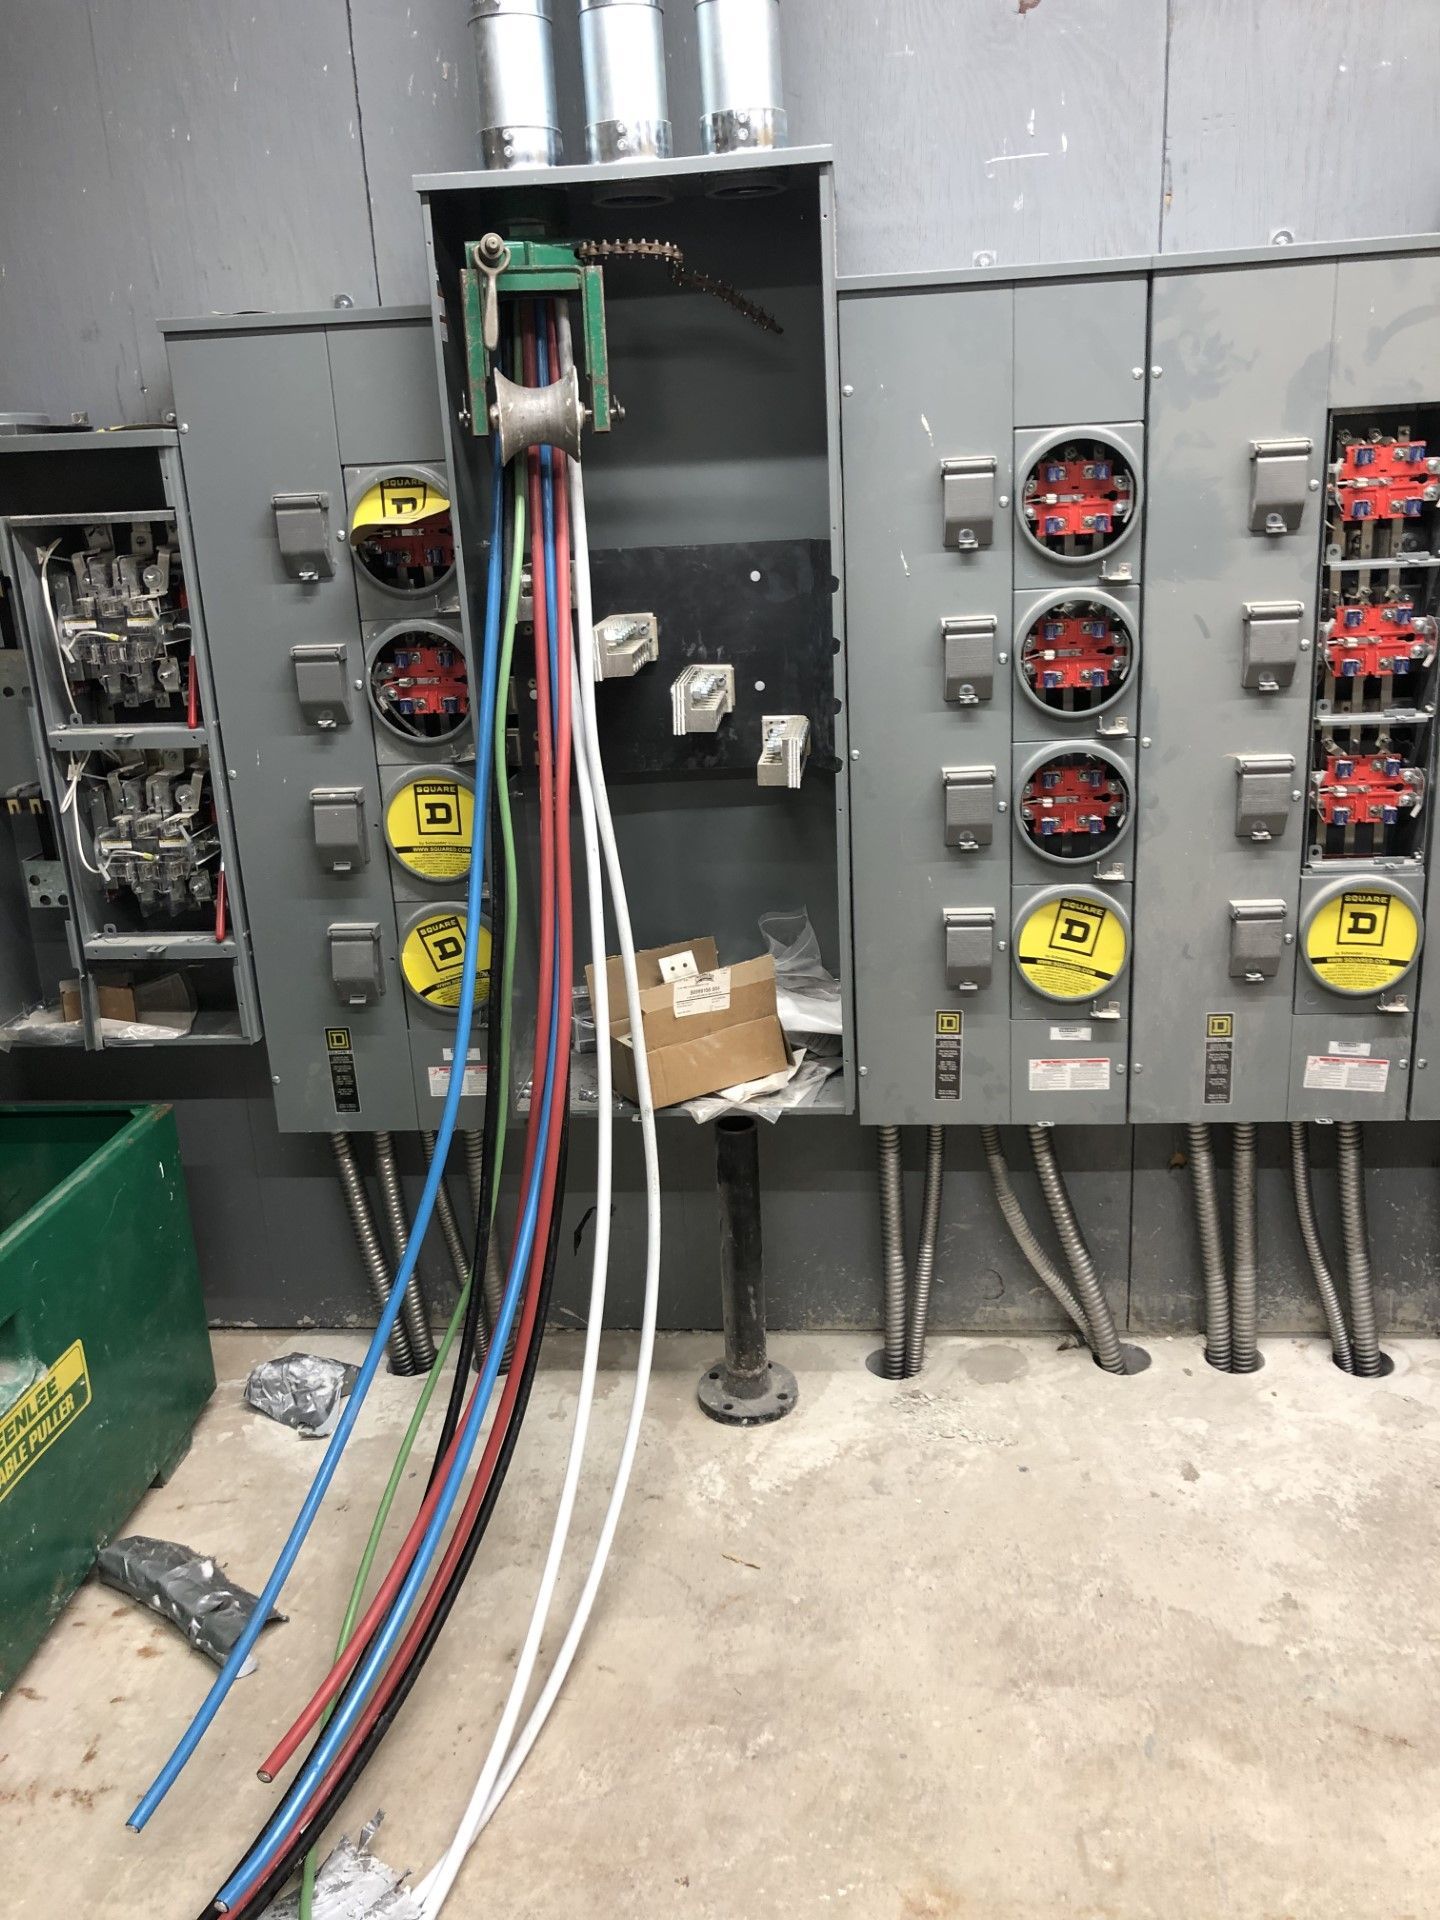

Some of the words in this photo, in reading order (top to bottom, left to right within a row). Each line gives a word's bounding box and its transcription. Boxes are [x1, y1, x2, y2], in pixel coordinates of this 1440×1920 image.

[383, 478, 424, 487] SQUARE
[424, 802, 453, 825] D
[1062, 900, 1104, 916] SQUARE
[1344, 894, 1388, 904] SQUARE
[420, 919, 457, 936] SQUARE
[1060, 917, 1091, 944] D
[1347, 911, 1378, 934] D
[432, 936, 463, 962] D
[28, 1393, 75, 1453] PULLER
